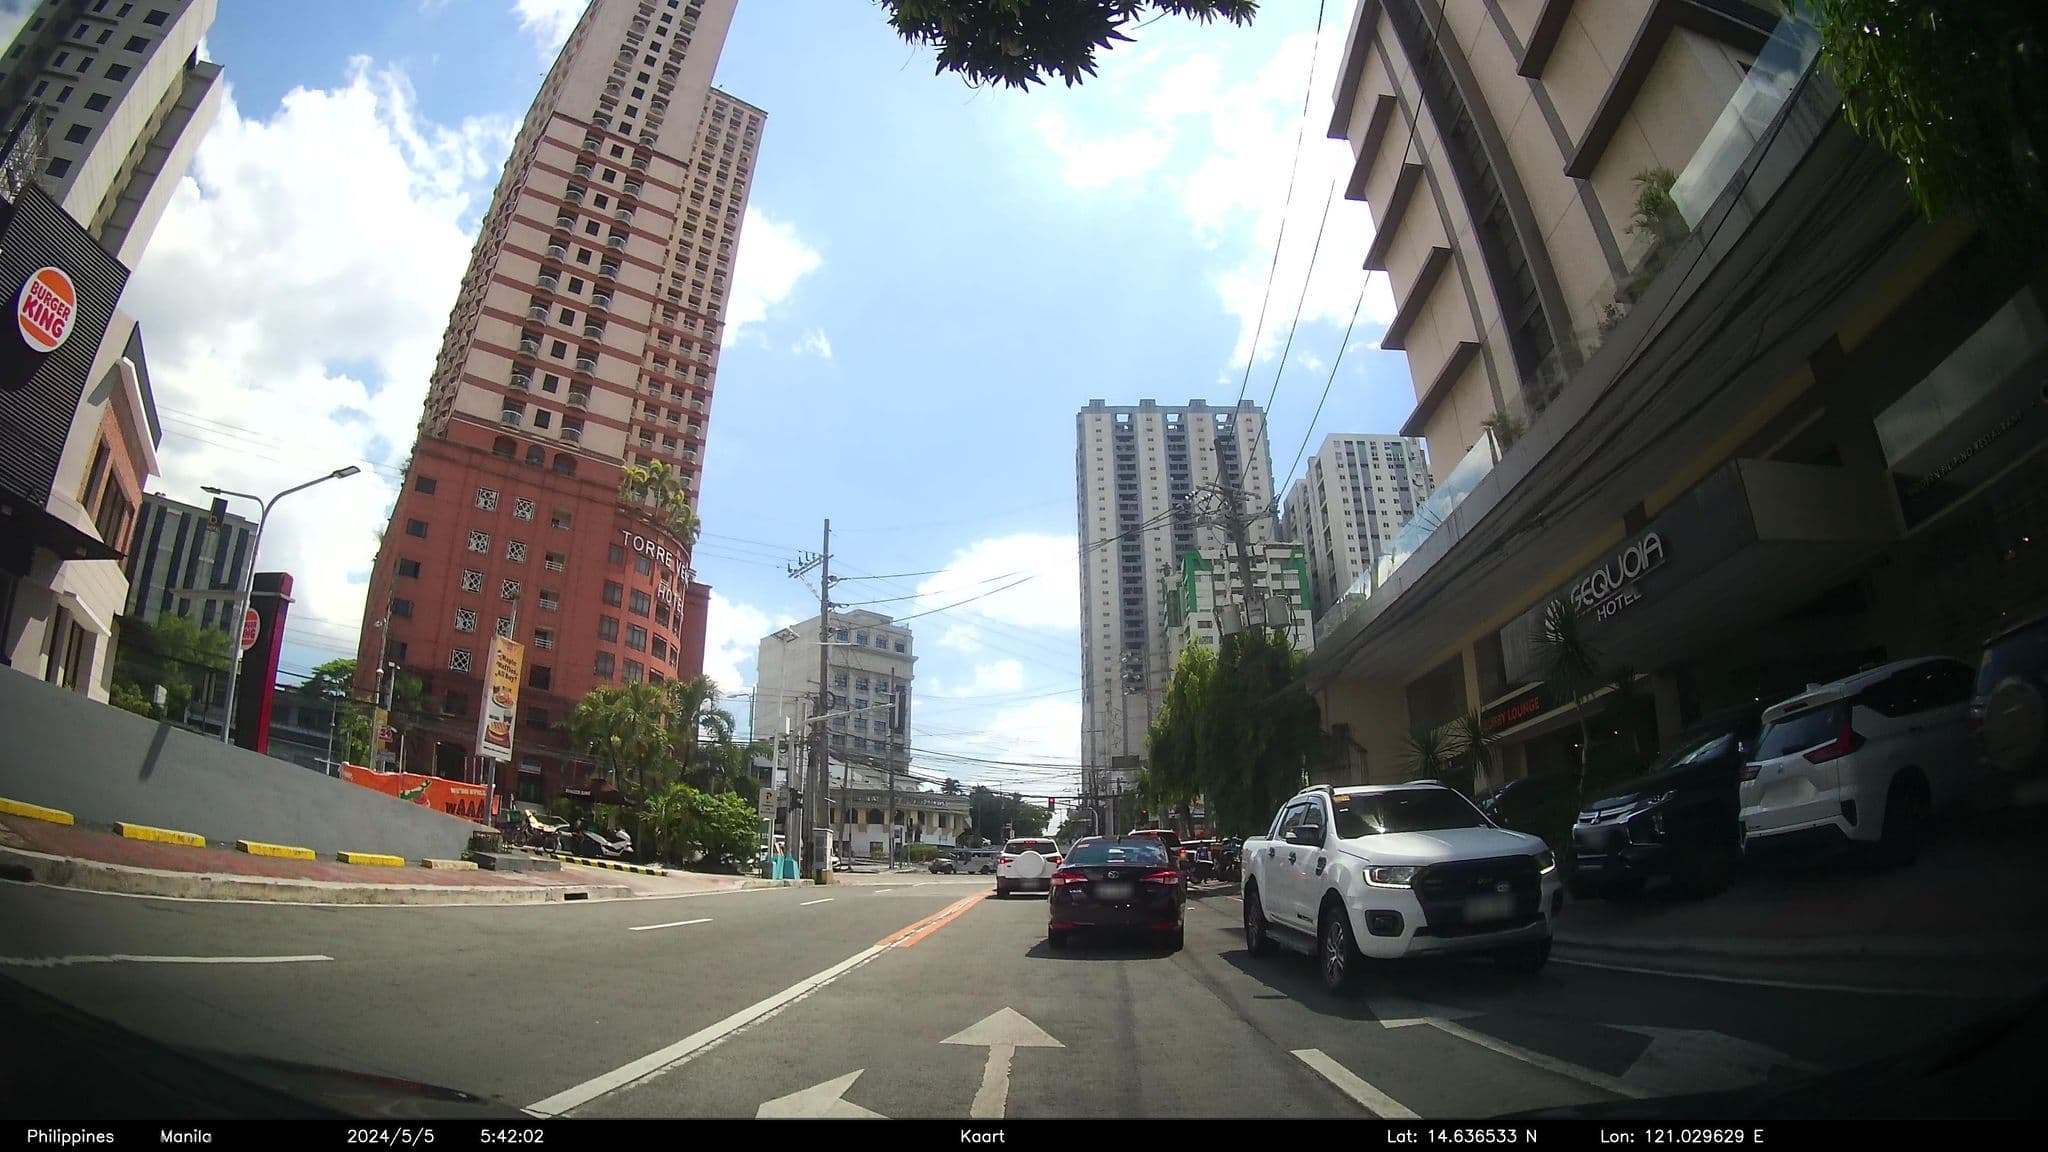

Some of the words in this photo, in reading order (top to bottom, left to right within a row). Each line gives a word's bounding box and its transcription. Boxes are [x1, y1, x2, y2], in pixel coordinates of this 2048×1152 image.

[22, 295, 66, 339] KING
[30, 281, 72, 321] BURGER
[622, 530, 673, 568] TORRE
[1570, 532, 1664, 612] SEQUOIA
[1597, 590, 1643, 622] HOTEL
[1507, 696, 1541, 721] LOUNGE
